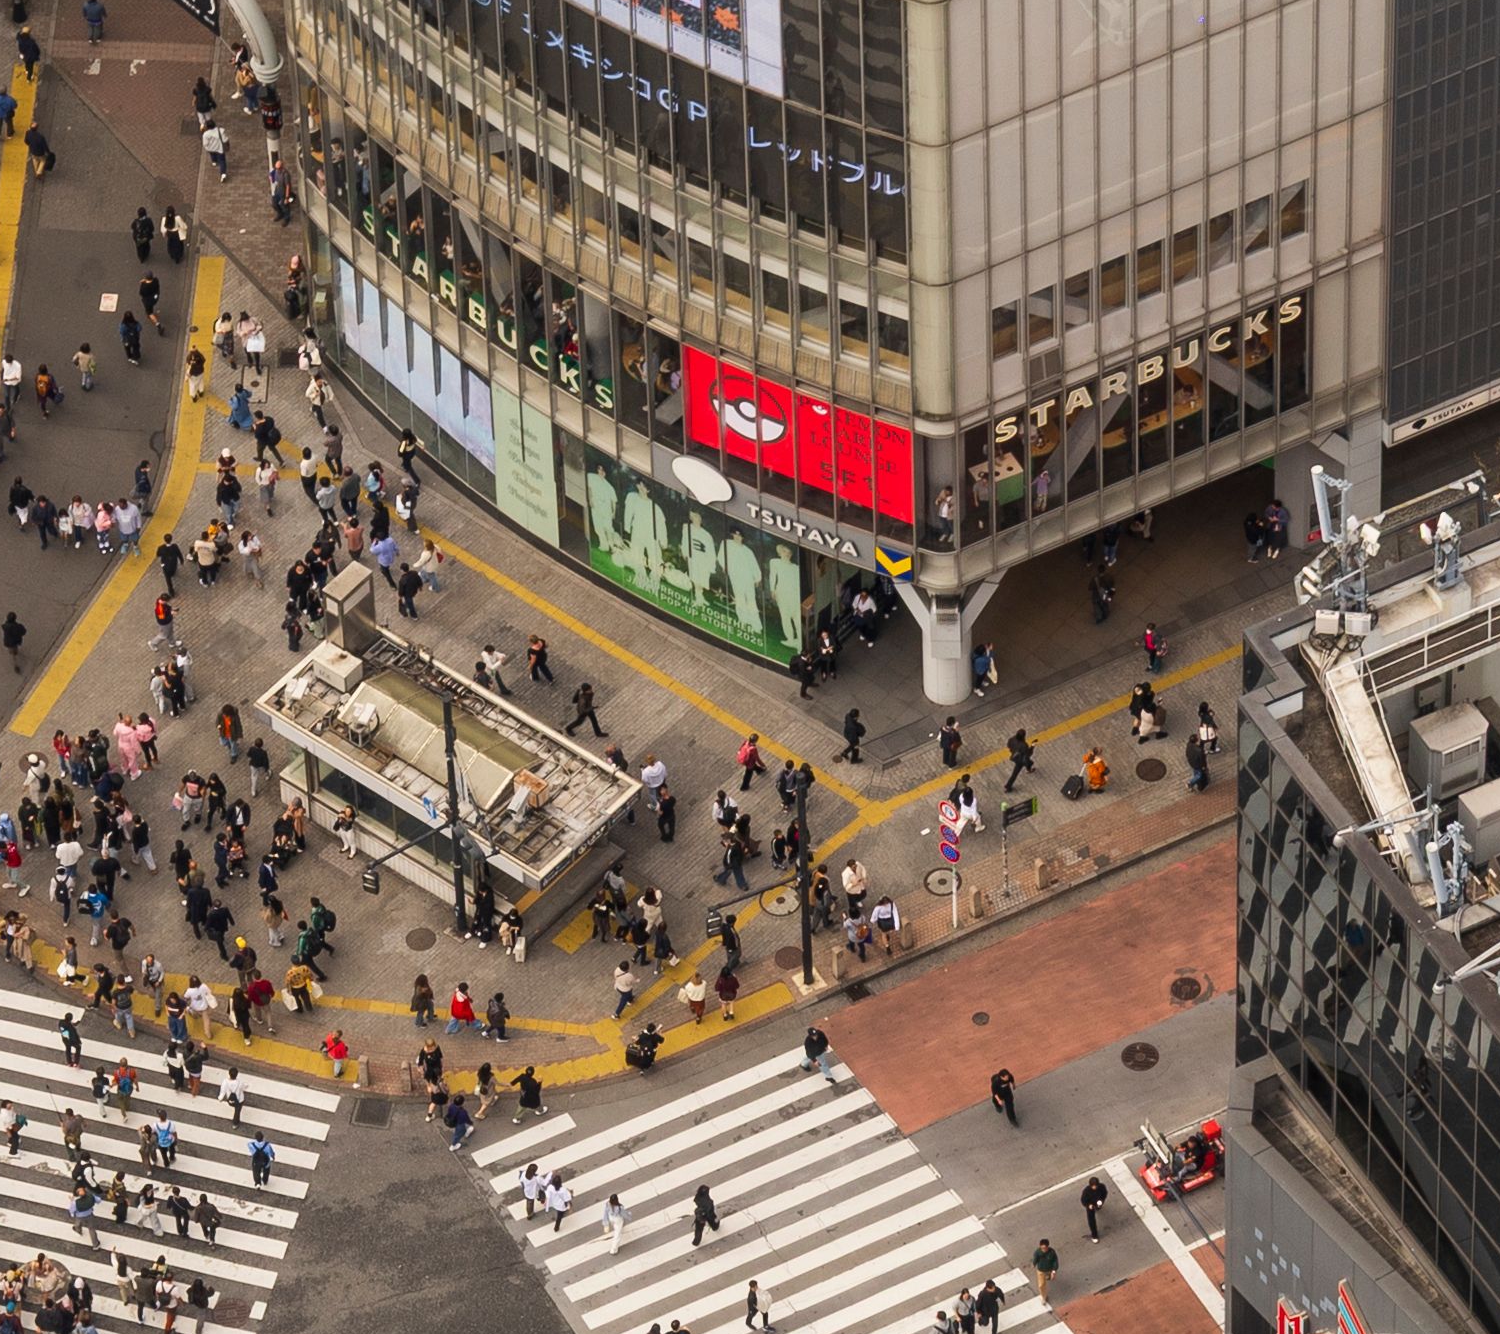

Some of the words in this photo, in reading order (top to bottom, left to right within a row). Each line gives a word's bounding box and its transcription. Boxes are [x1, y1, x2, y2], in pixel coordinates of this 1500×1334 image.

[362, 210, 615, 411] STARBUCKS
[995, 296, 1303, 445] STARBUCKS
[1432, 399, 1475, 426] TSUTAYA
[745, 502, 861, 559] TSUTAYA
[659, 593, 699, 618] POP-UP
[700, 612, 736, 637] STORE
[735, 624, 766, 649] 2025
[701, 604, 763, 636] TOGETHER
